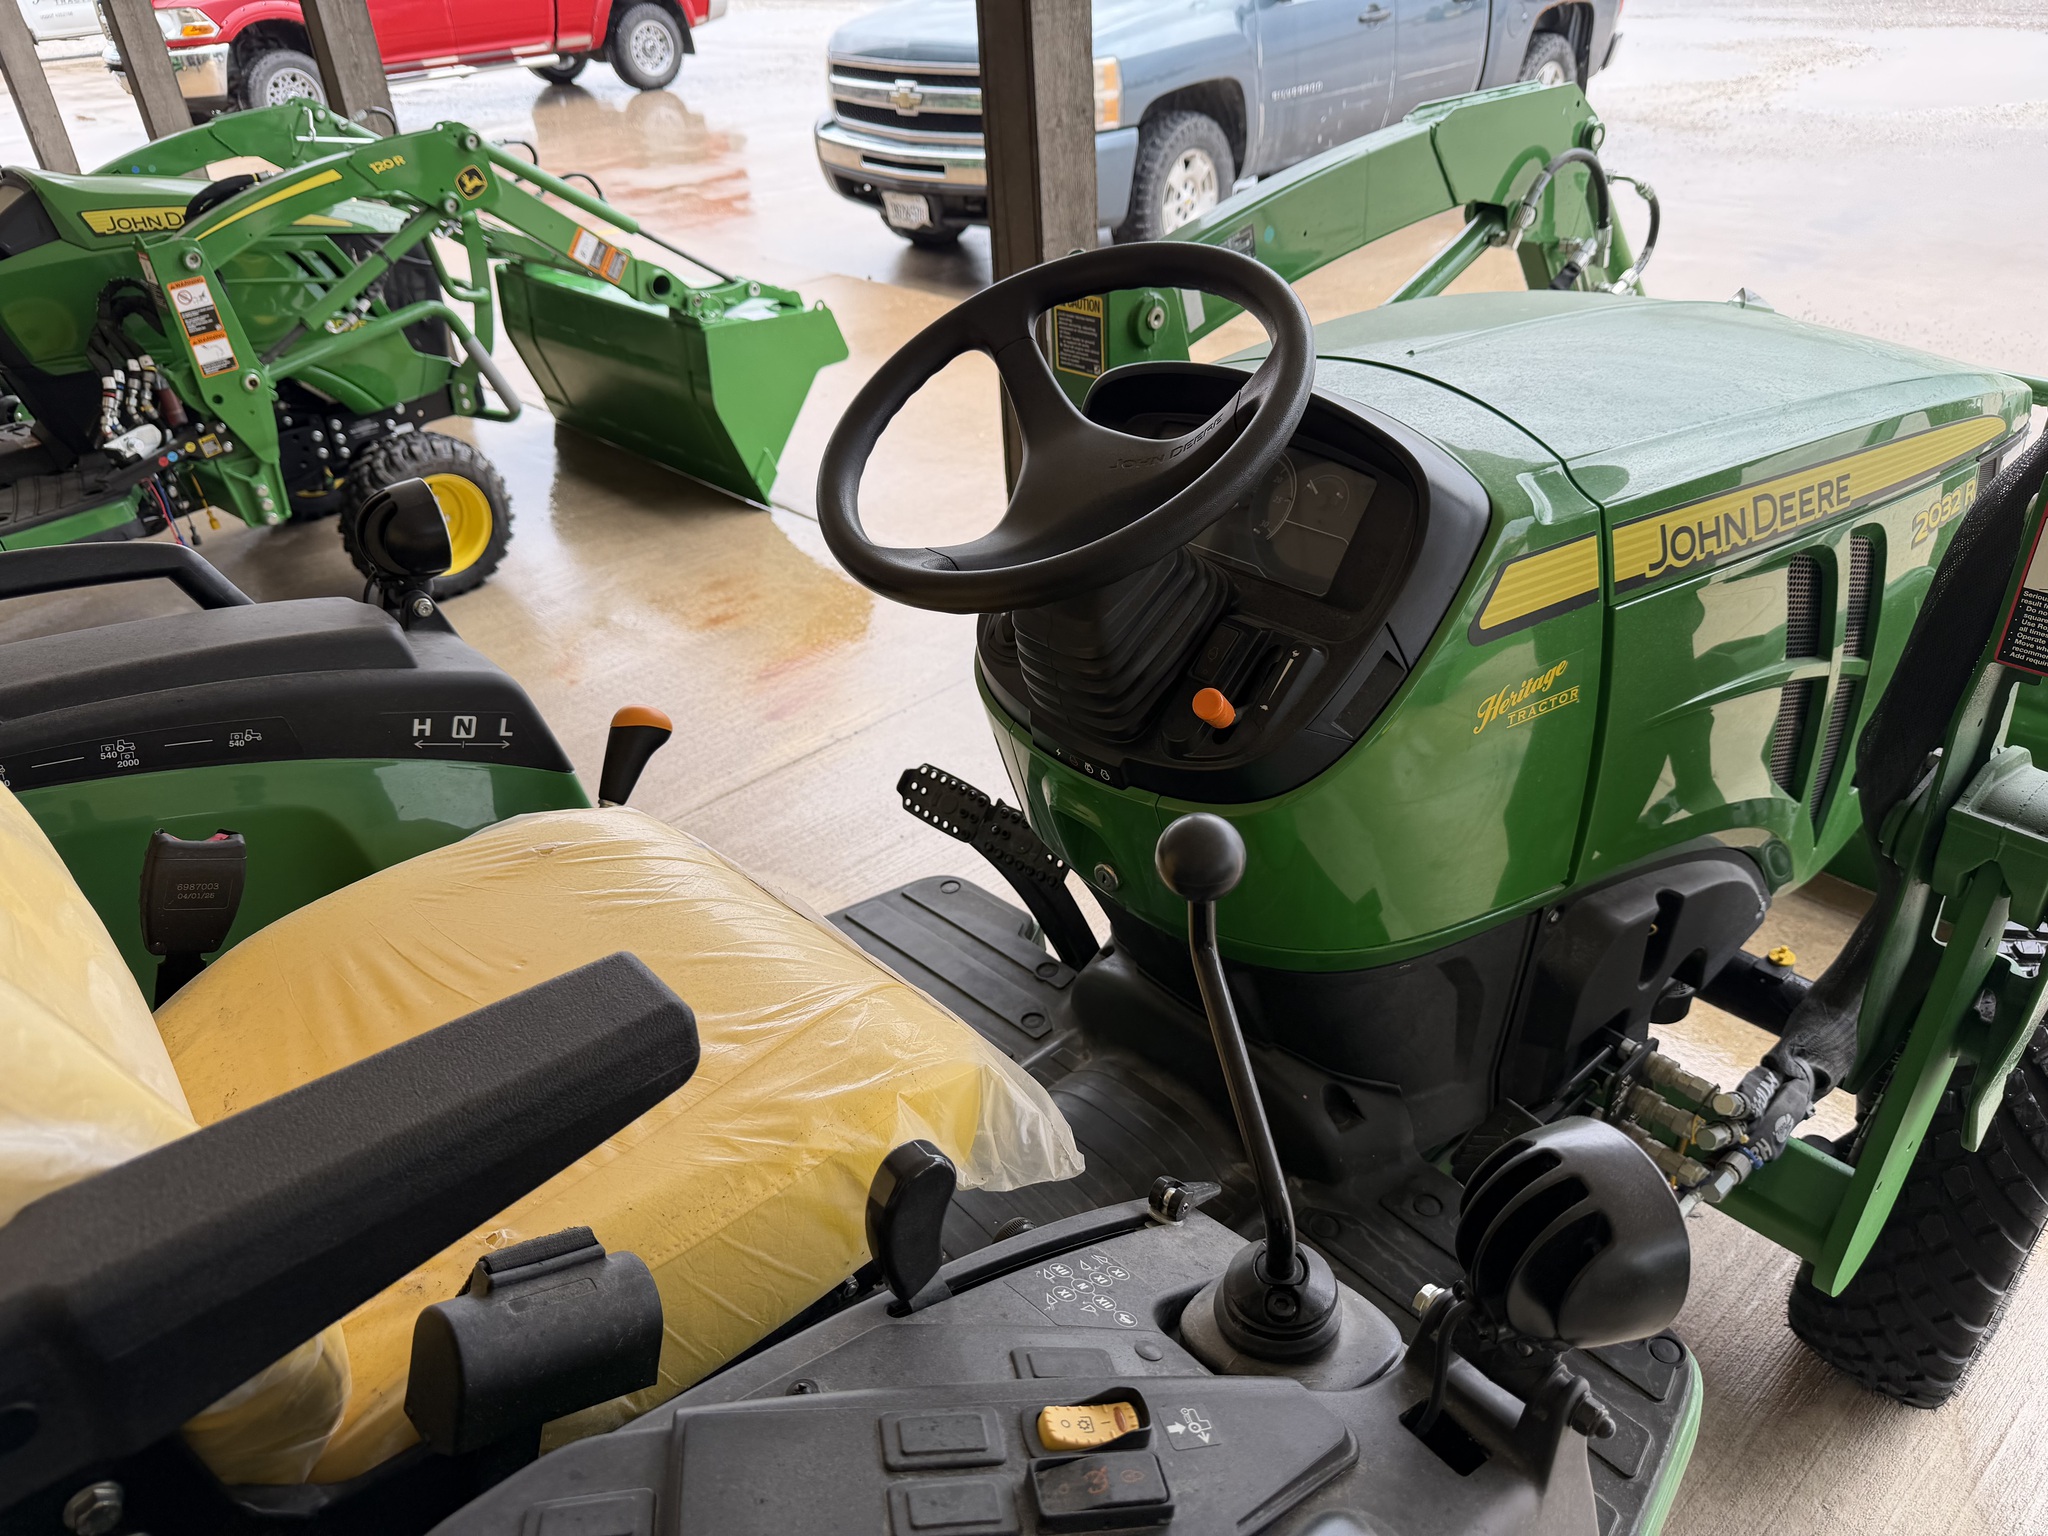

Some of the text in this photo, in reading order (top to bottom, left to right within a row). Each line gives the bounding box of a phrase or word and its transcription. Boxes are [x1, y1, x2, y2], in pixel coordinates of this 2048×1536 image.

[106, 215, 163, 233] JOHN
[1109, 413, 1223, 469] JOHN DEERE
[1912, 478, 1977, 547] 2032 R
[1648, 473, 1851, 572] JOHN DEERE
[2023, 590, 2048, 602] Seriou
[2021, 598, 2042, 608] result
[2025, 605, 2037, 614] Do
[2021, 619, 2036, 628] Use
[2014, 638, 2035, 649] Move
[2017, 632, 2046, 645] Operate
[2010, 651, 2026, 661] Add
[1473, 659, 1569, 735] Heritage
[1508, 688, 1580, 725] TRACTOR
[412, 717, 513, 737] H N L
[228, 739, 245, 748] 540
[100, 751, 118, 760] 540
[116, 758, 140, 768] 2000
[177, 882, 220, 891] 6987003
